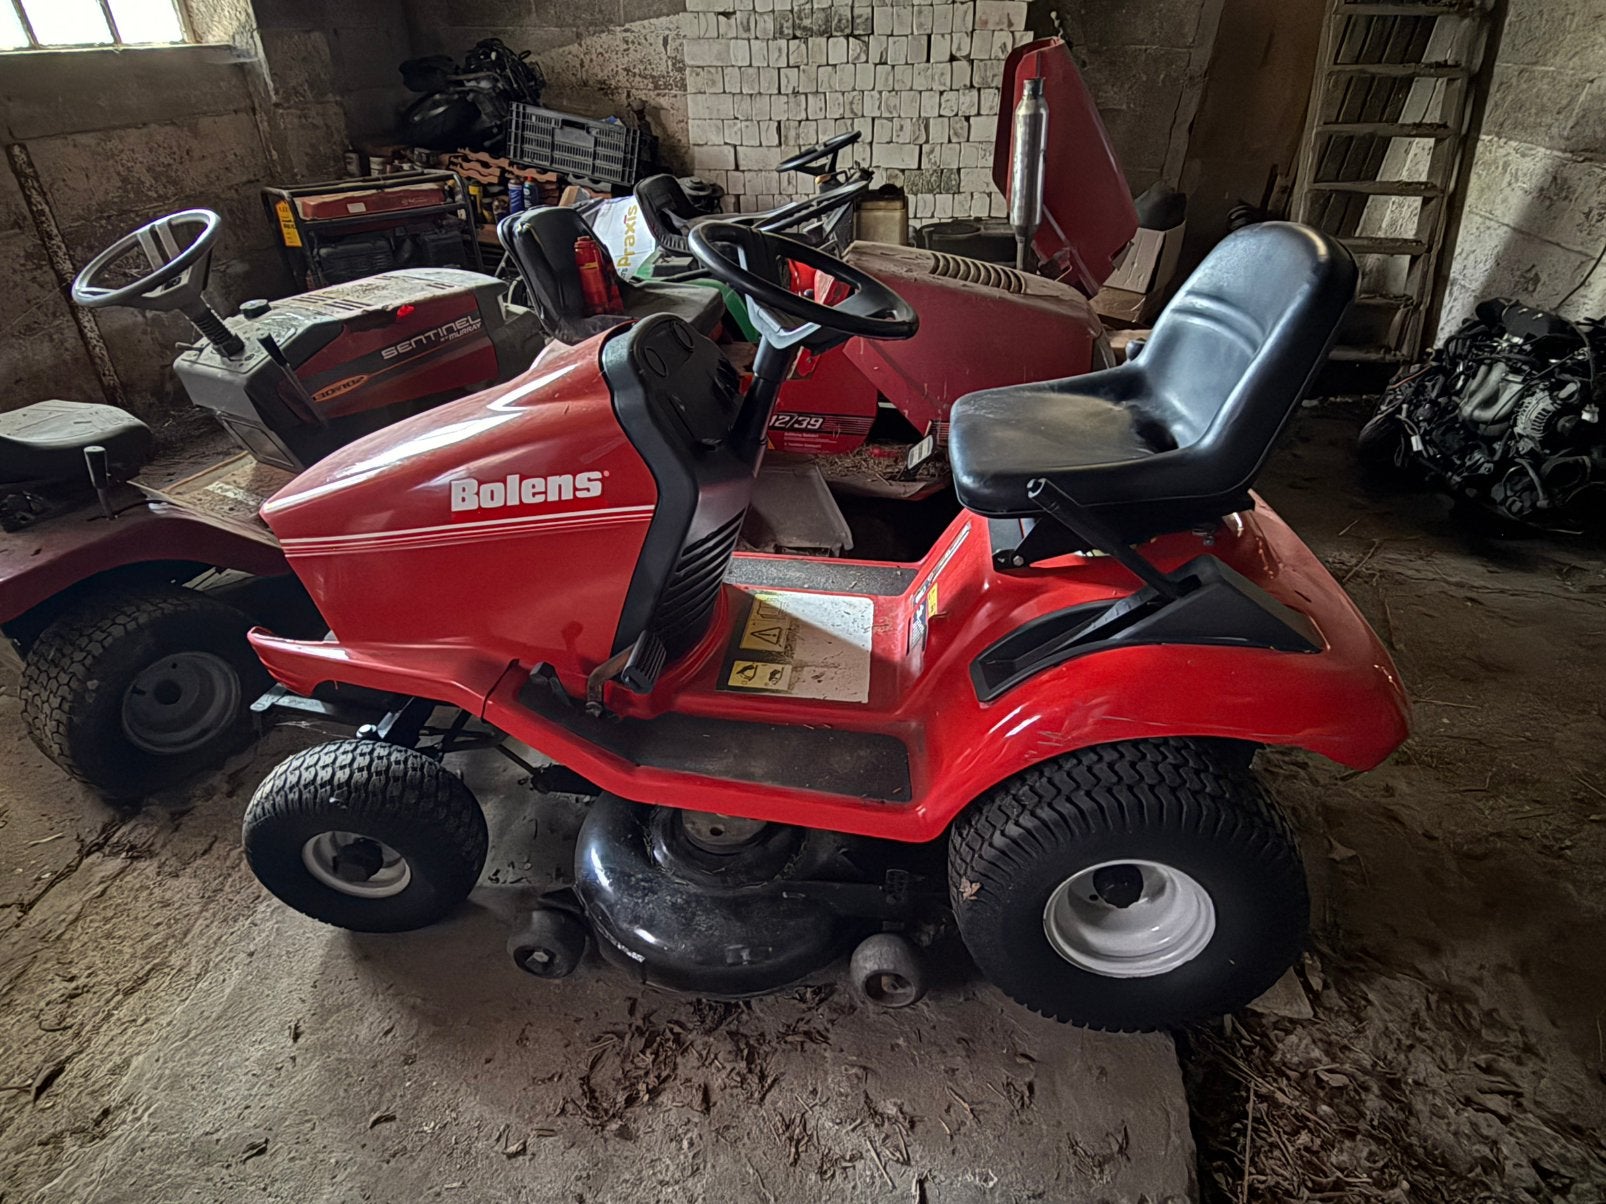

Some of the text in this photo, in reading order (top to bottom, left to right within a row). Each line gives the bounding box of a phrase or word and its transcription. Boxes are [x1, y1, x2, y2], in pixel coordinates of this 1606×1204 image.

[616, 204, 638, 267] Praxis
[381, 315, 481, 360] SENTINEL
[449, 321, 482, 341] MURRAY
[768, 414, 824, 429] 12/39
[451, 471, 603, 512] Bolens
